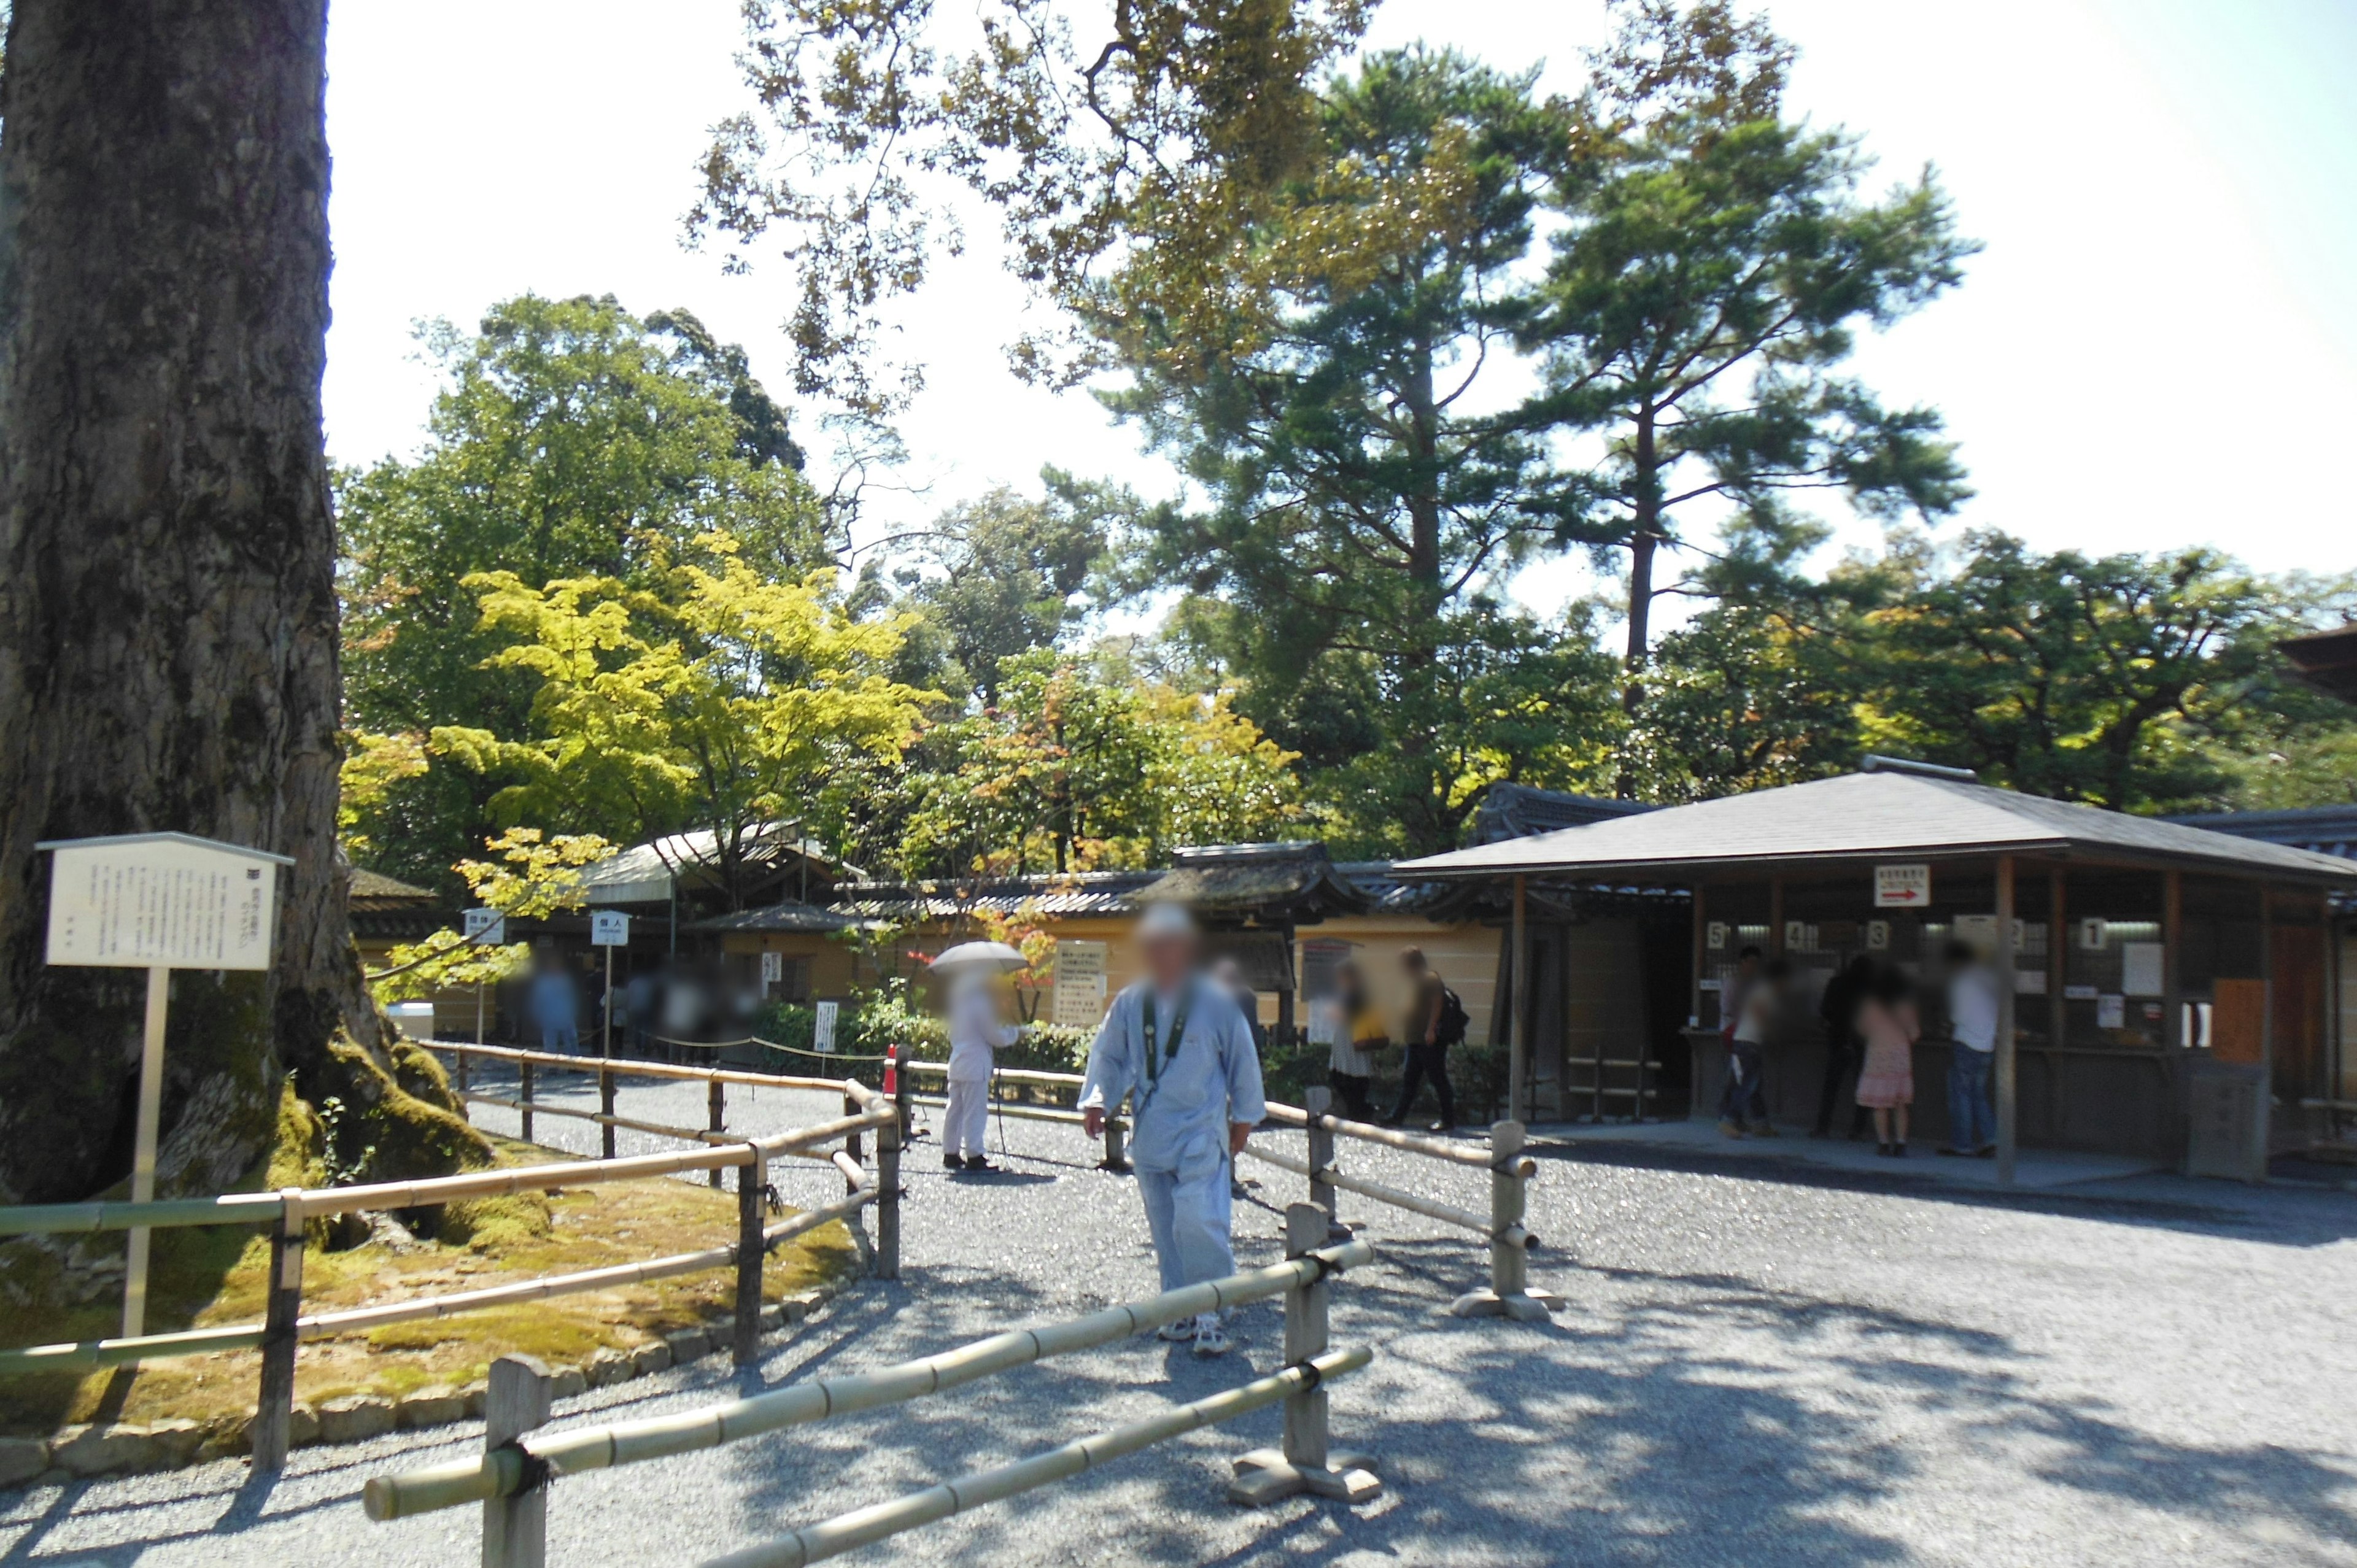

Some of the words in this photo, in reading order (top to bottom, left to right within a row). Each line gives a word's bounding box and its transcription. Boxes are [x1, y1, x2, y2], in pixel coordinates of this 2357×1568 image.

[1711, 925, 1721, 944] 5
[1788, 925, 1799, 944] 4
[1871, 925, 1883, 944] 3
[2087, 925, 2097, 944] 1
